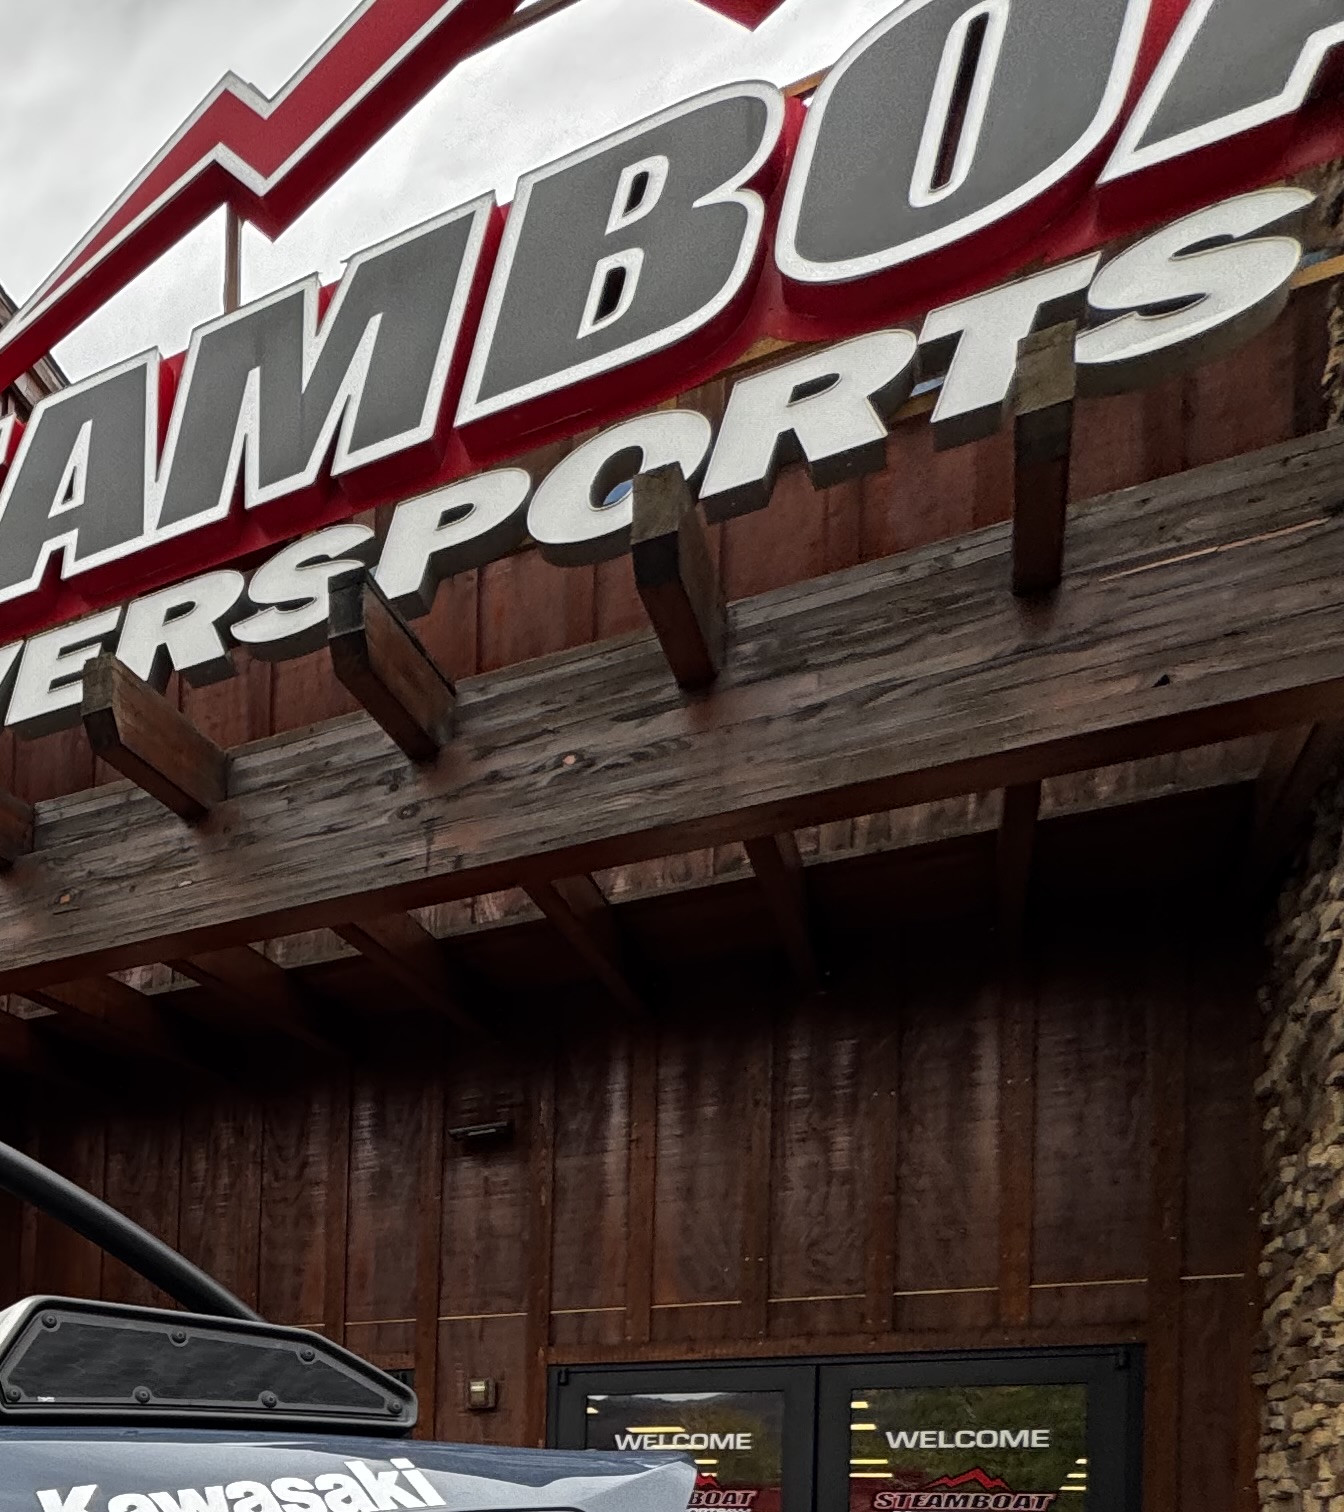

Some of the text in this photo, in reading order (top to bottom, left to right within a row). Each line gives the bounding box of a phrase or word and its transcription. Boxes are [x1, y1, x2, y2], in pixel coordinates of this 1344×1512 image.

[614, 1432, 752, 1451] WELCOME
[885, 1429, 1050, 1449] WELCOME
[873, 1491, 1057, 1510] STEAMBOAT
